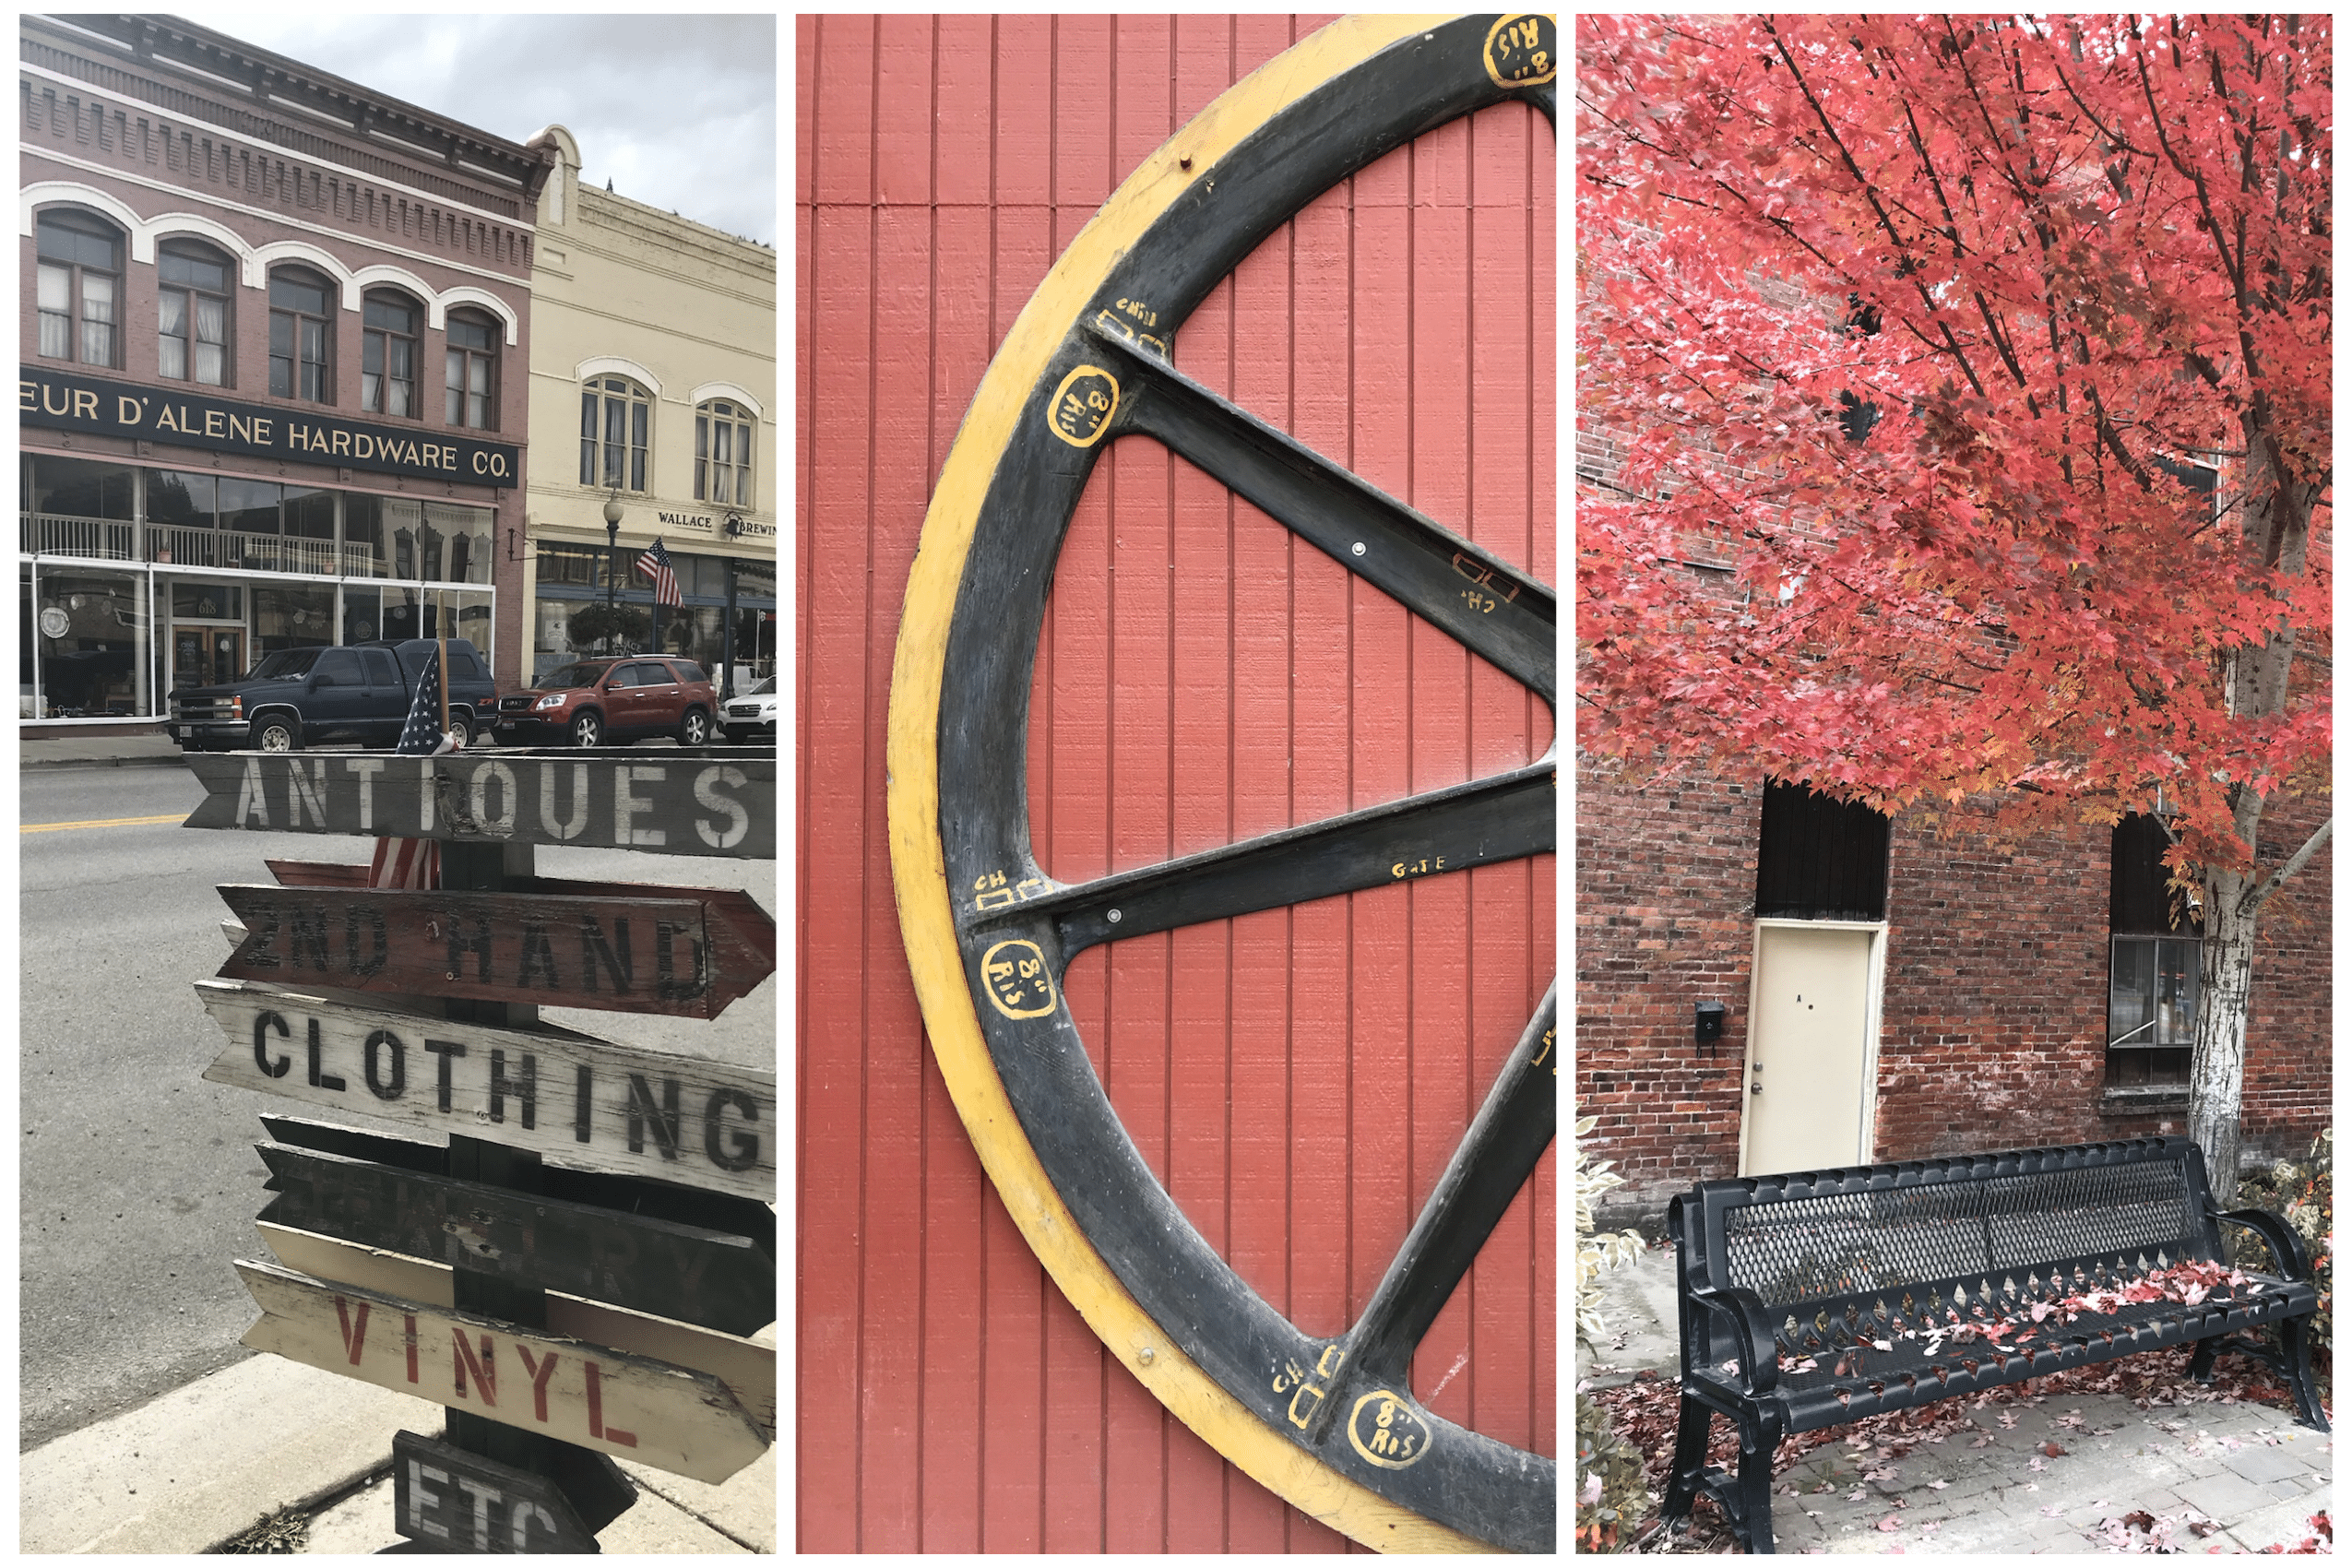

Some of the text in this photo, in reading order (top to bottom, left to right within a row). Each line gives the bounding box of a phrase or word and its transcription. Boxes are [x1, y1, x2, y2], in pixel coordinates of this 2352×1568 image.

[288, 422, 458, 472] HARDWARE
[471, 451, 511, 479] CO.
[658, 512, 712, 529] WALLACE
[235, 757, 749, 849] ANTIQUES
[974, 870, 1007, 891] CH
[446, 909, 709, 1003] HAND
[254, 1010, 760, 1173] CLOTHING
[334, 1296, 637, 1448] VINYL
[408, 1459, 557, 1554] ETC
